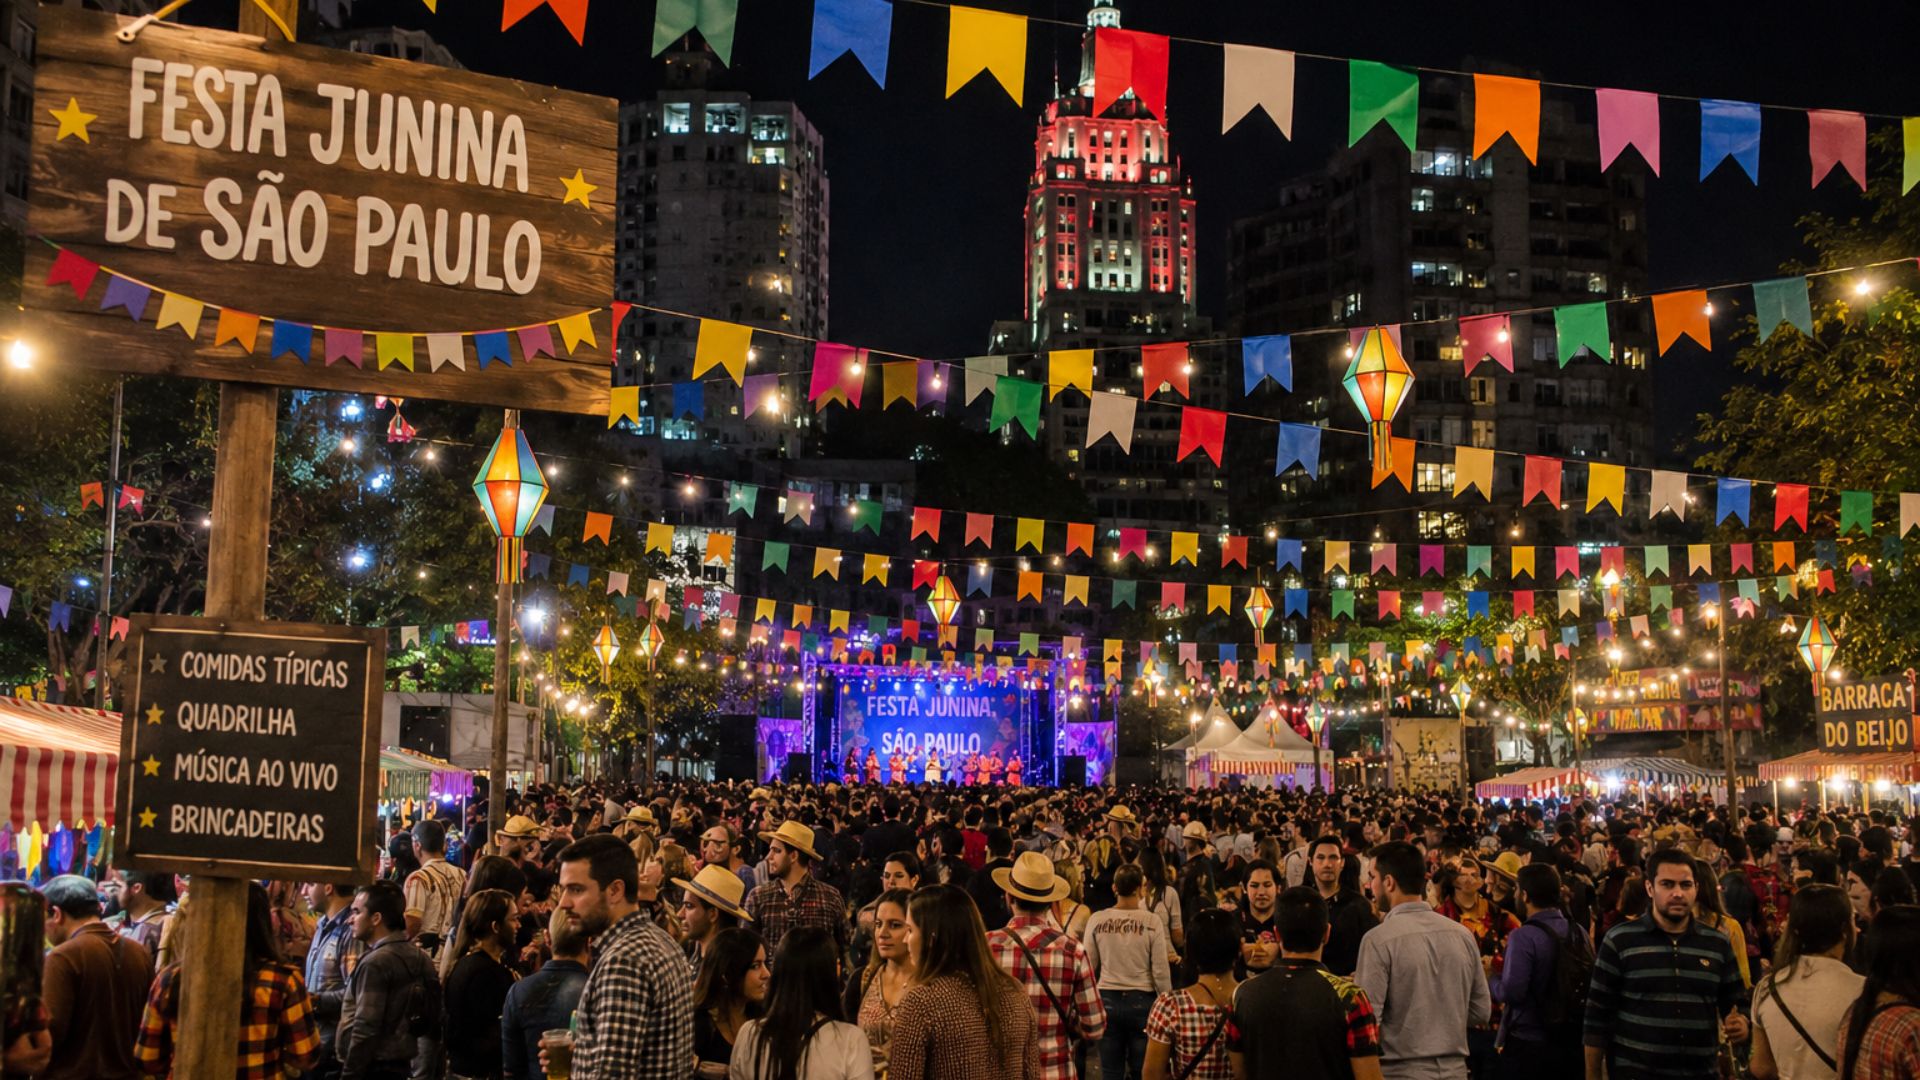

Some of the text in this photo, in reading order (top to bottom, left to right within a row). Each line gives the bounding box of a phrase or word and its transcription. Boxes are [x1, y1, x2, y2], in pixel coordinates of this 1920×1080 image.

[129, 57, 529, 193] FESTA JUNINA
[105, 169, 542, 295] DE SÃO PAULO
[180, 650, 348, 689] COMIDAS TÍPICAS
[867, 695, 919, 717] FESTA
[1821, 682, 1906, 712] BARRACA
[177, 701, 296, 736] QUADRILHA
[1824, 718, 1908, 748] DO BEIJO
[924, 732, 981, 756] PAULO
[174, 748, 338, 792] MÚSICA AO VIVO
[170, 804, 324, 843] BRINCADEIRAS
